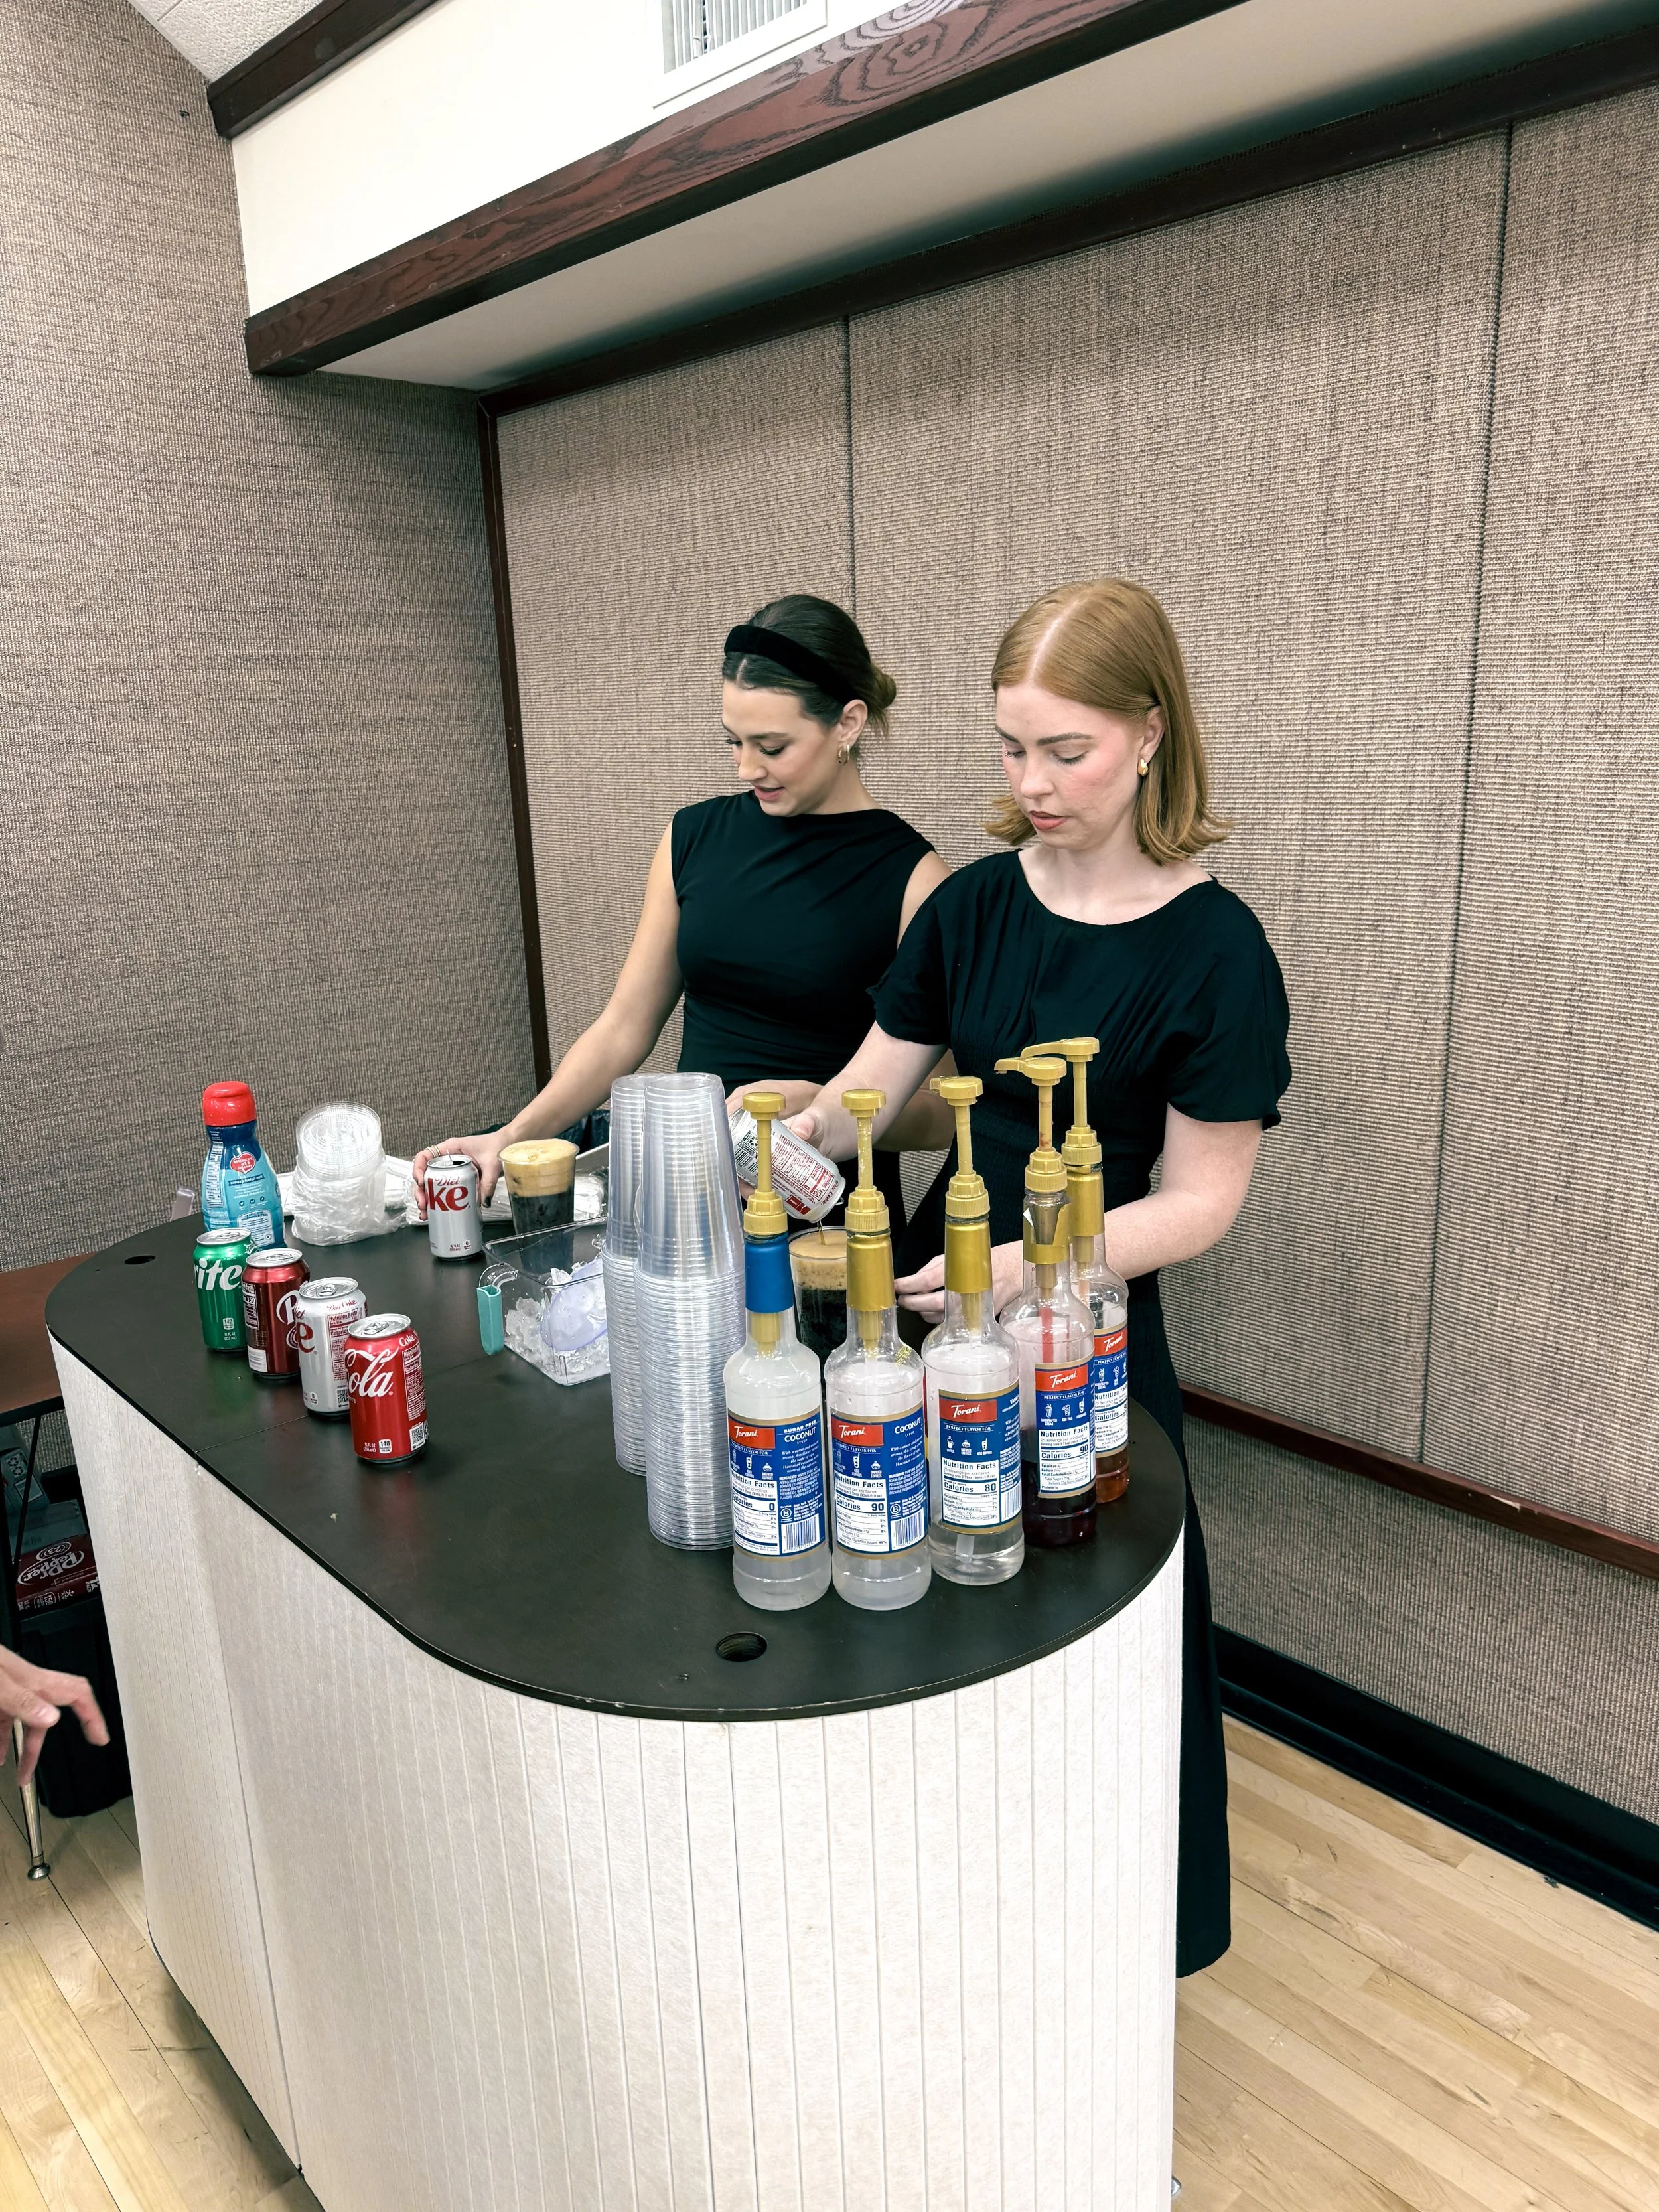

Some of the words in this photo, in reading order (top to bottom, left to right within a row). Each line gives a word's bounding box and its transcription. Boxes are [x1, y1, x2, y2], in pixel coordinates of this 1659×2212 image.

[435, 1176, 460, 1187] Diet
[427, 1177, 469, 1211] ke
[399, 1334, 416, 1347] Coke
[1104, 1332, 1123, 1352] Torani
[1049, 1370, 1077, 1388] Torani
[1094, 1391, 1119, 1400] Nutrition
[951, 1404, 981, 1418] Torani
[1095, 1412, 1119, 1421] Calories
[805, 1419, 817, 1428] FREE
[895, 1417, 921, 1434] COCONUT
[1074, 1426, 1088, 1434] Facts
[734, 1426, 758, 1439] Torani
[784, 1427, 816, 1443] COCONUT
[839, 1425, 865, 1438] Torani
[1080, 1444, 1088, 1453] 90
[943, 1459, 974, 1470] Nutrition
[732, 1472, 751, 1485] Nutrition
[835, 1475, 859, 1487] Nutrition
[944, 1482, 974, 1493] Calories
[985, 1483, 997, 1492] 80
[733, 1492, 753, 1508] Calories
[837, 1497, 861, 1511] Calories
[871, 1503, 884, 1511] 90
[47, 1546, 61, 1556] 23
[23, 1551, 84, 1580] Pepper
[40, 1566, 64, 1580] Dr
[43, 1594, 53, 1606] 150
